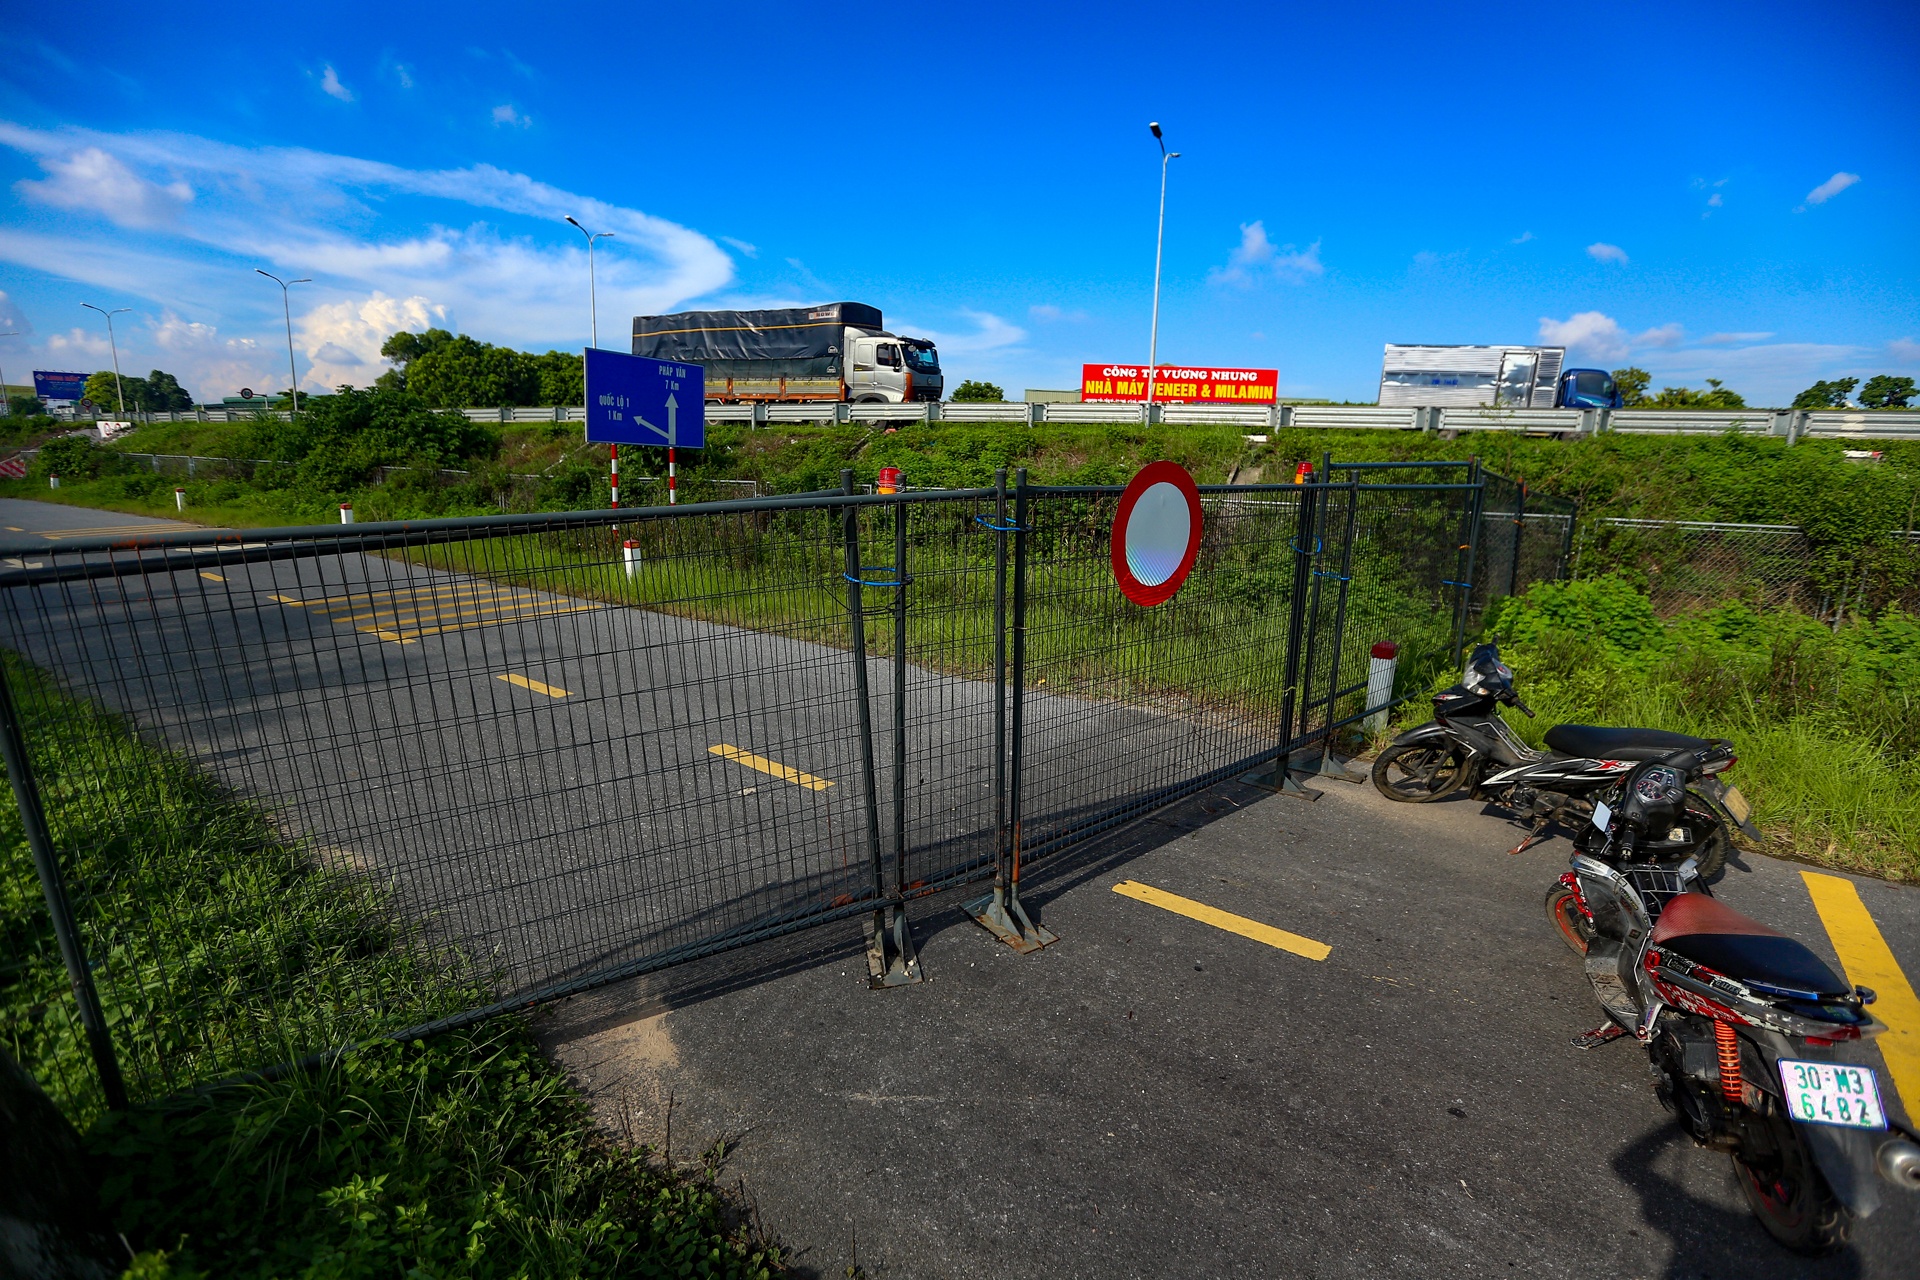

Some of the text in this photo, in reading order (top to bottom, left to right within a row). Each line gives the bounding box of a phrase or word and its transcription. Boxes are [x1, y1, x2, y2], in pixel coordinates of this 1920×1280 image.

[659, 365, 686, 378] PHÁP VÂN
[1103, 365, 1137, 377] CÔNG
[1162, 369, 1208, 380] VƯƠNG
[1211, 371, 1257, 381] NHUNG
[665, 379, 679, 391] 7 Km
[1085, 378, 1112, 394] NHÀ
[1116, 379, 1145, 395] MÁY
[1201, 384, 1211, 398] &
[1215, 384, 1273, 399] MILAMIN
[599, 392, 630, 410] QUỐC LỘ 1
[608, 410, 622, 421] 1 Km
[1800, 1093, 1872, 1125] 6482
